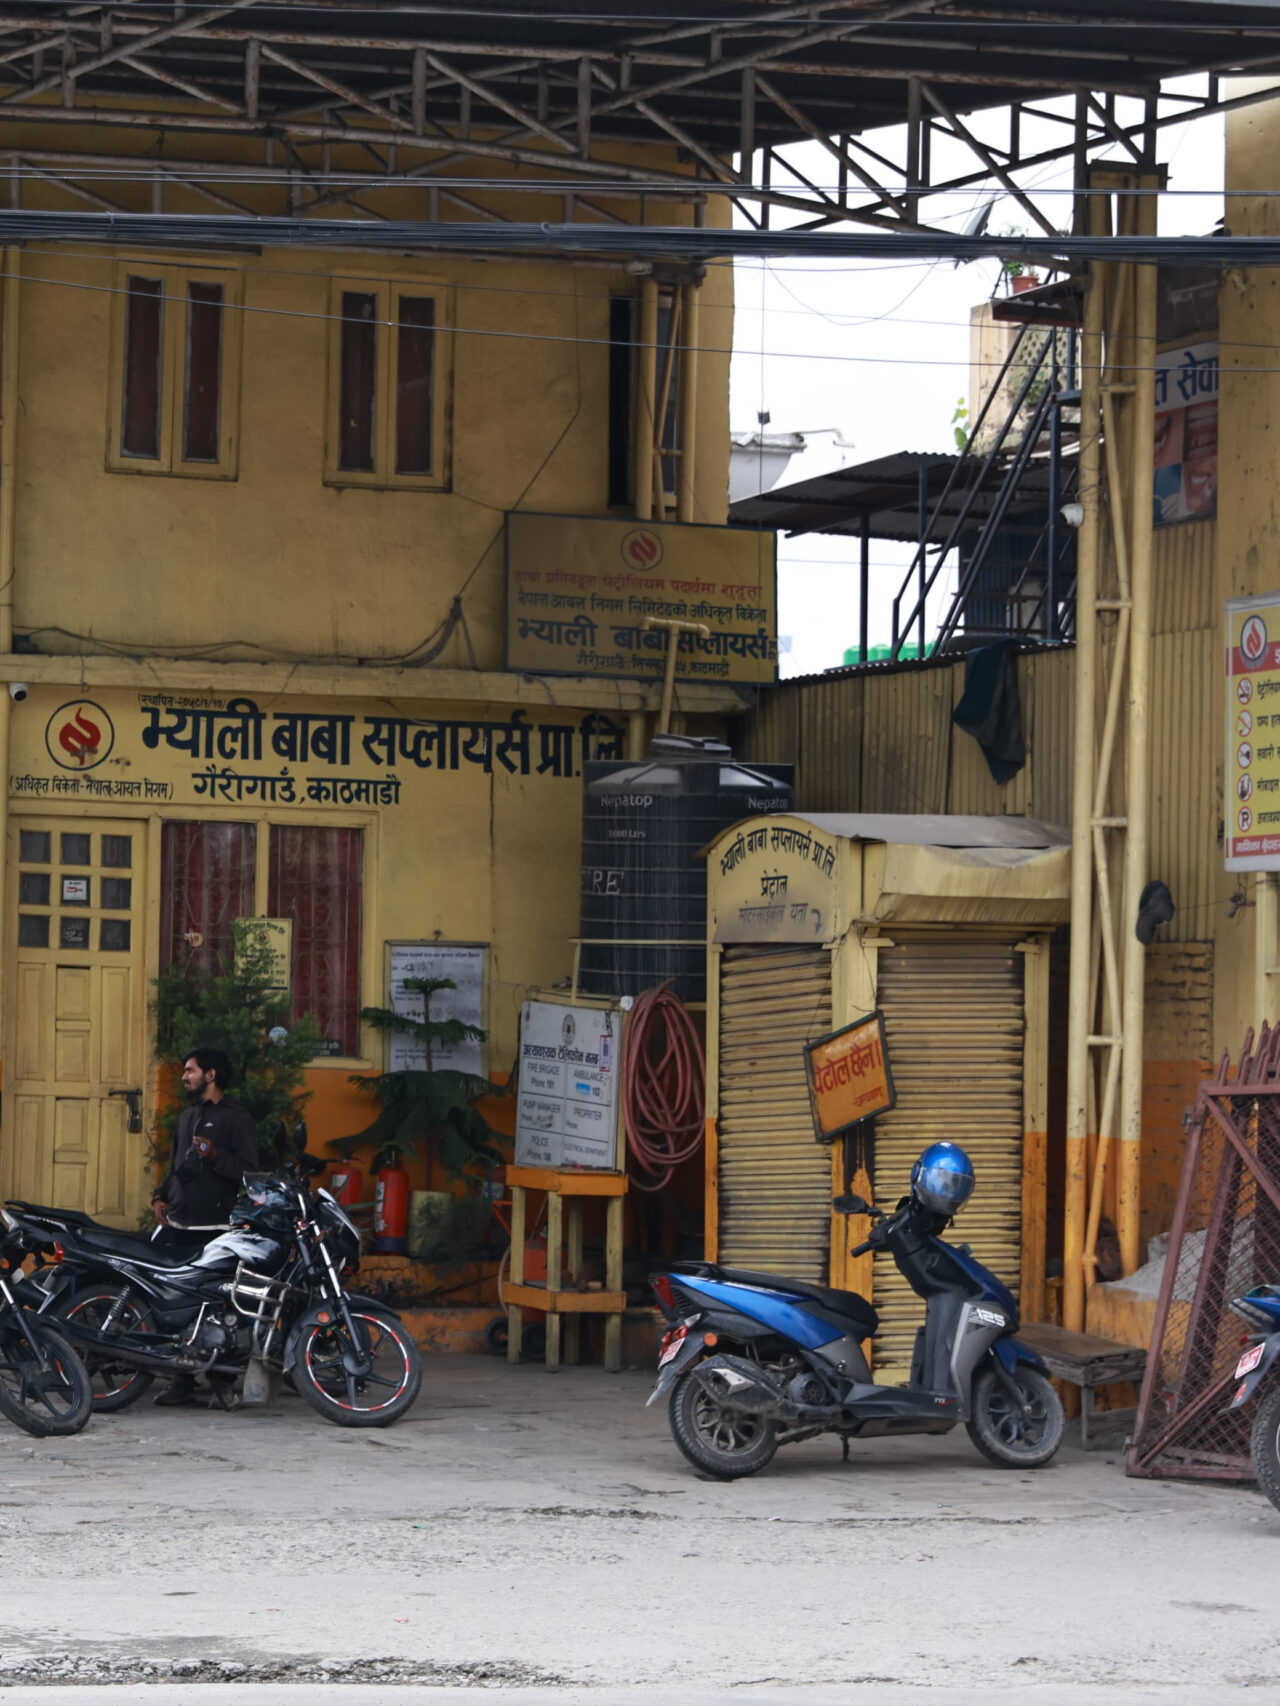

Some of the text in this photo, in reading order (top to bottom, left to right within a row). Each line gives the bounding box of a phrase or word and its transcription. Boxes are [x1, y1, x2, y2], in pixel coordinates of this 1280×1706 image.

[272, 712, 356, 766] बाबा
[361, 710, 533, 776] सप्लायर्स
[601, 794, 653, 809] Nepatop
[748, 797, 789, 812] Nepatop
[747, 828, 768, 853] बाबा
